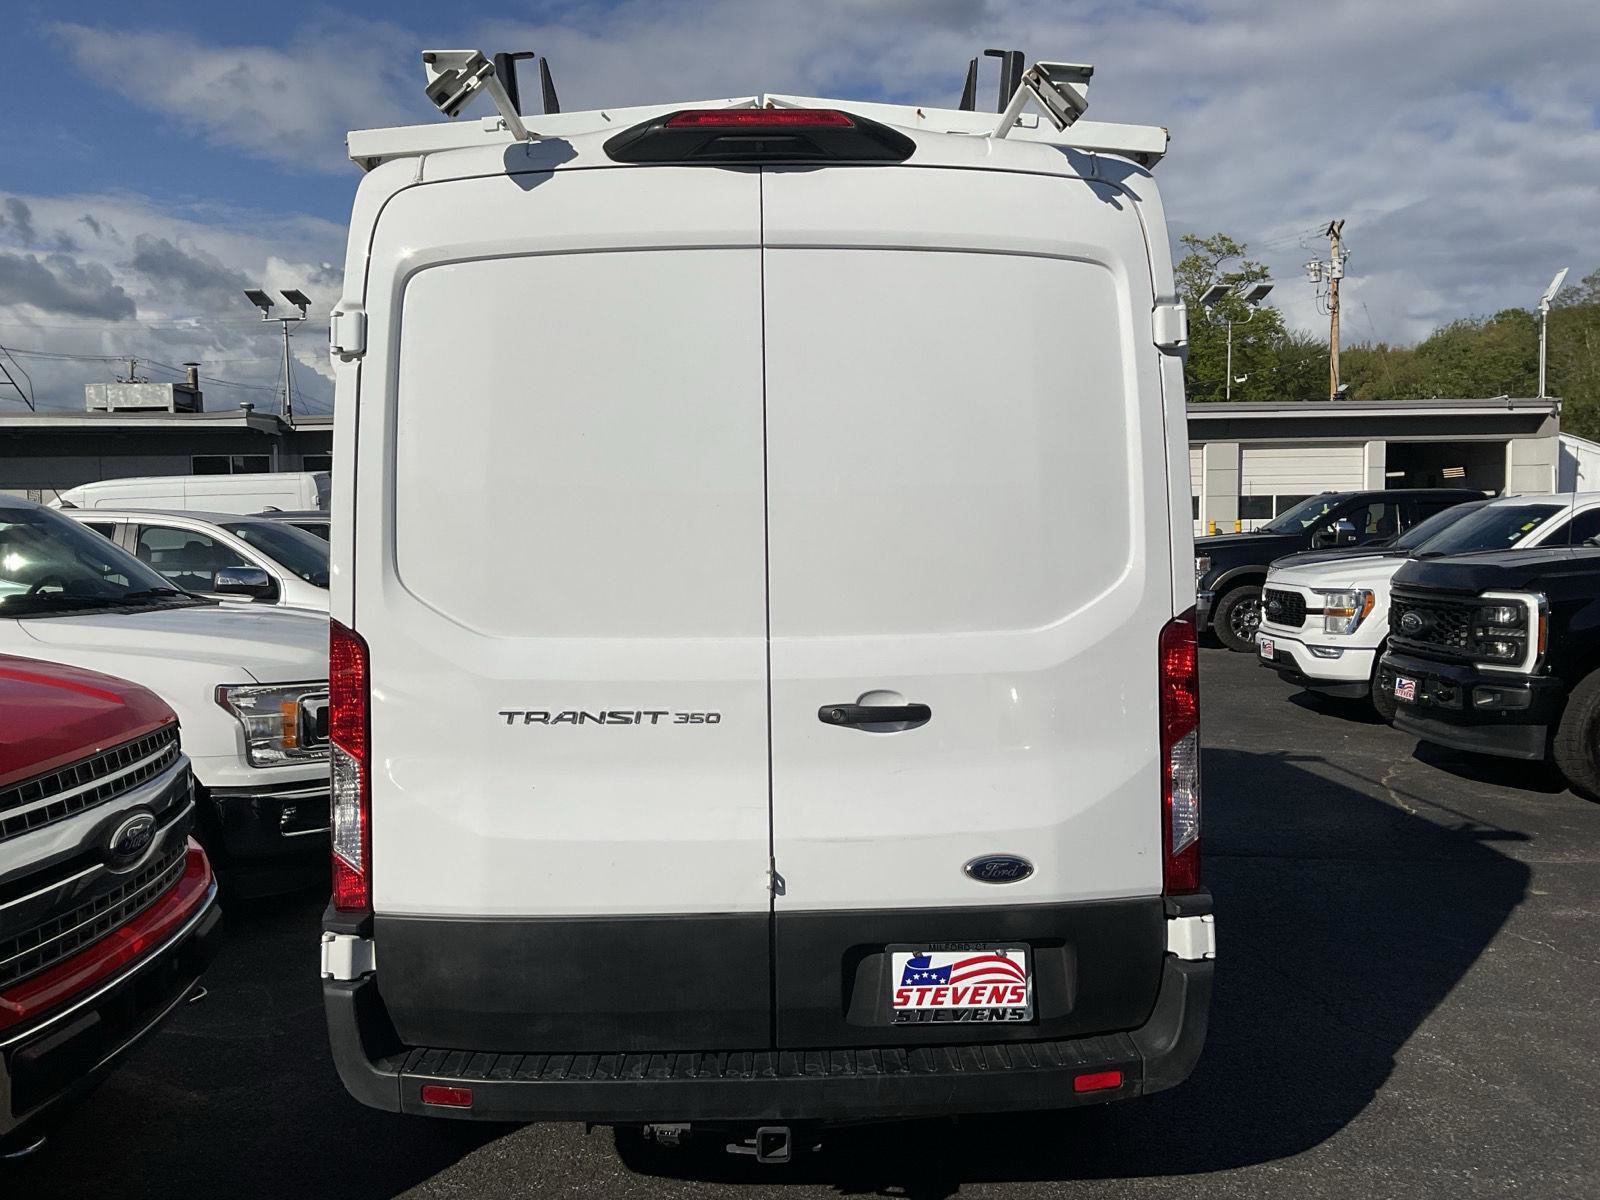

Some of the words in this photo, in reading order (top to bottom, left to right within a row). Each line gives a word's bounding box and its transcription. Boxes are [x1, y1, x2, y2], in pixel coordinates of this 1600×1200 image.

[498, 711, 669, 724] TRANSIT
[673, 712, 721, 723] 350
[981, 862, 1018, 877] Ford
[893, 986, 1026, 1006] STEVENS
[894, 1008, 1025, 1022] STEVENS
